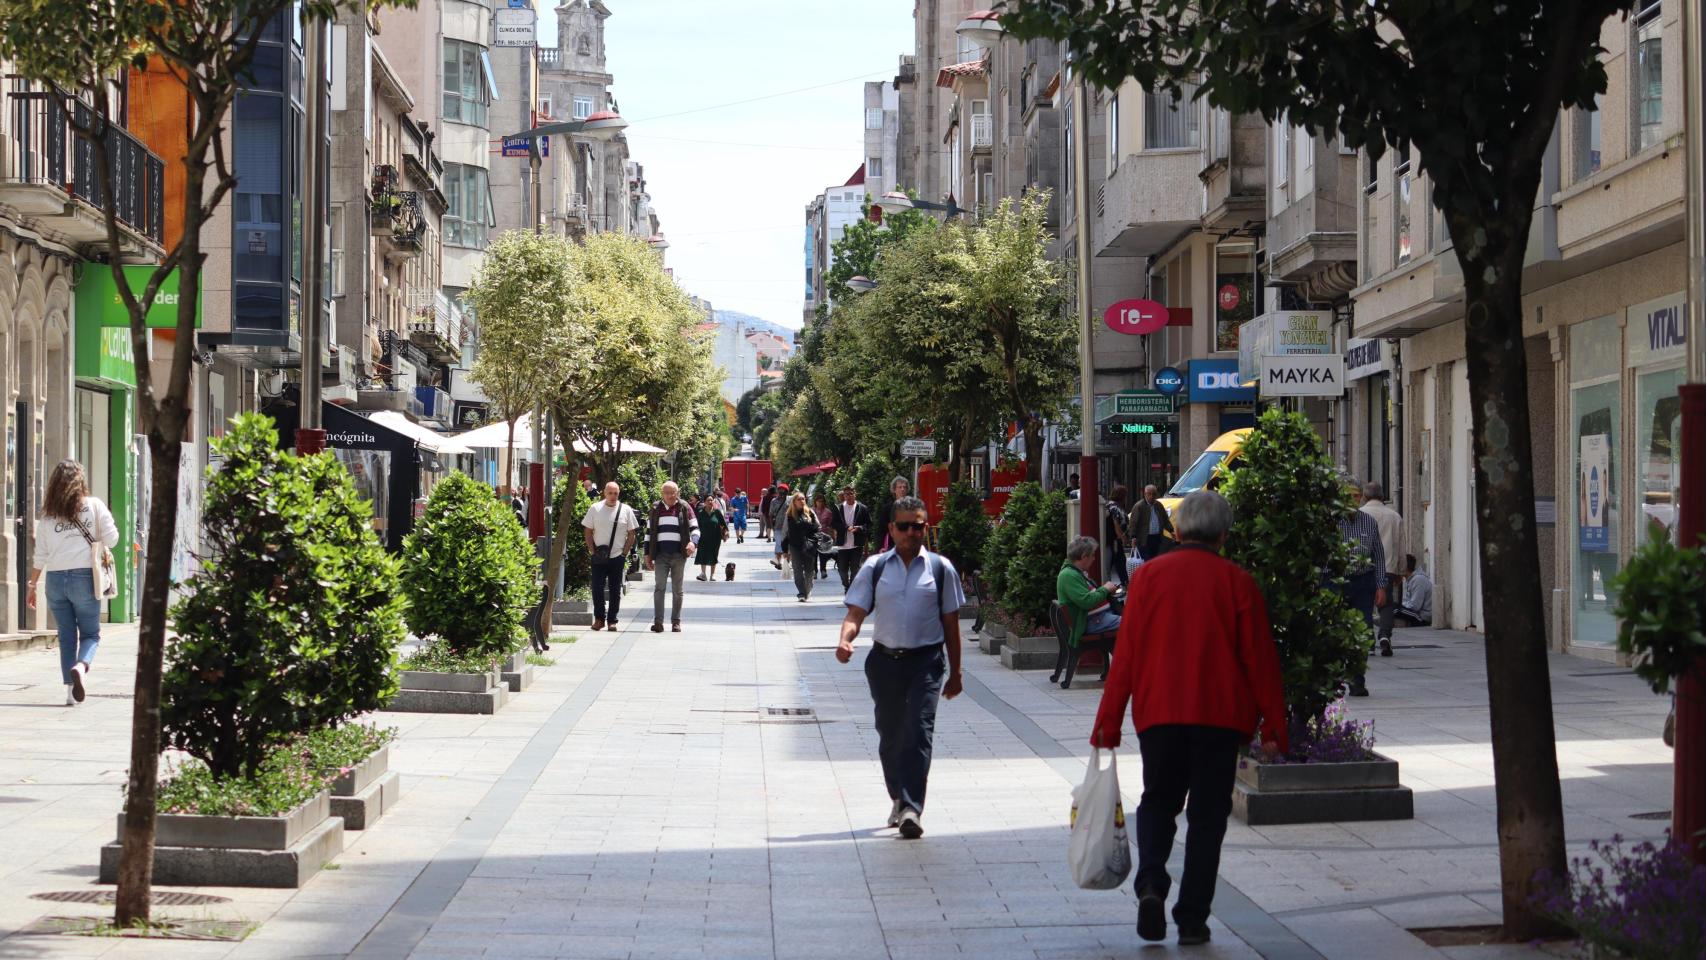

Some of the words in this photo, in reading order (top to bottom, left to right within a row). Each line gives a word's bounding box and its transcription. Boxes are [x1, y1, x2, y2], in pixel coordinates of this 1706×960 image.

[1288, 315, 1319, 331] GRAN
[1269, 367, 1335, 384] MAYKA
[1122, 423, 1154, 433] Natura
